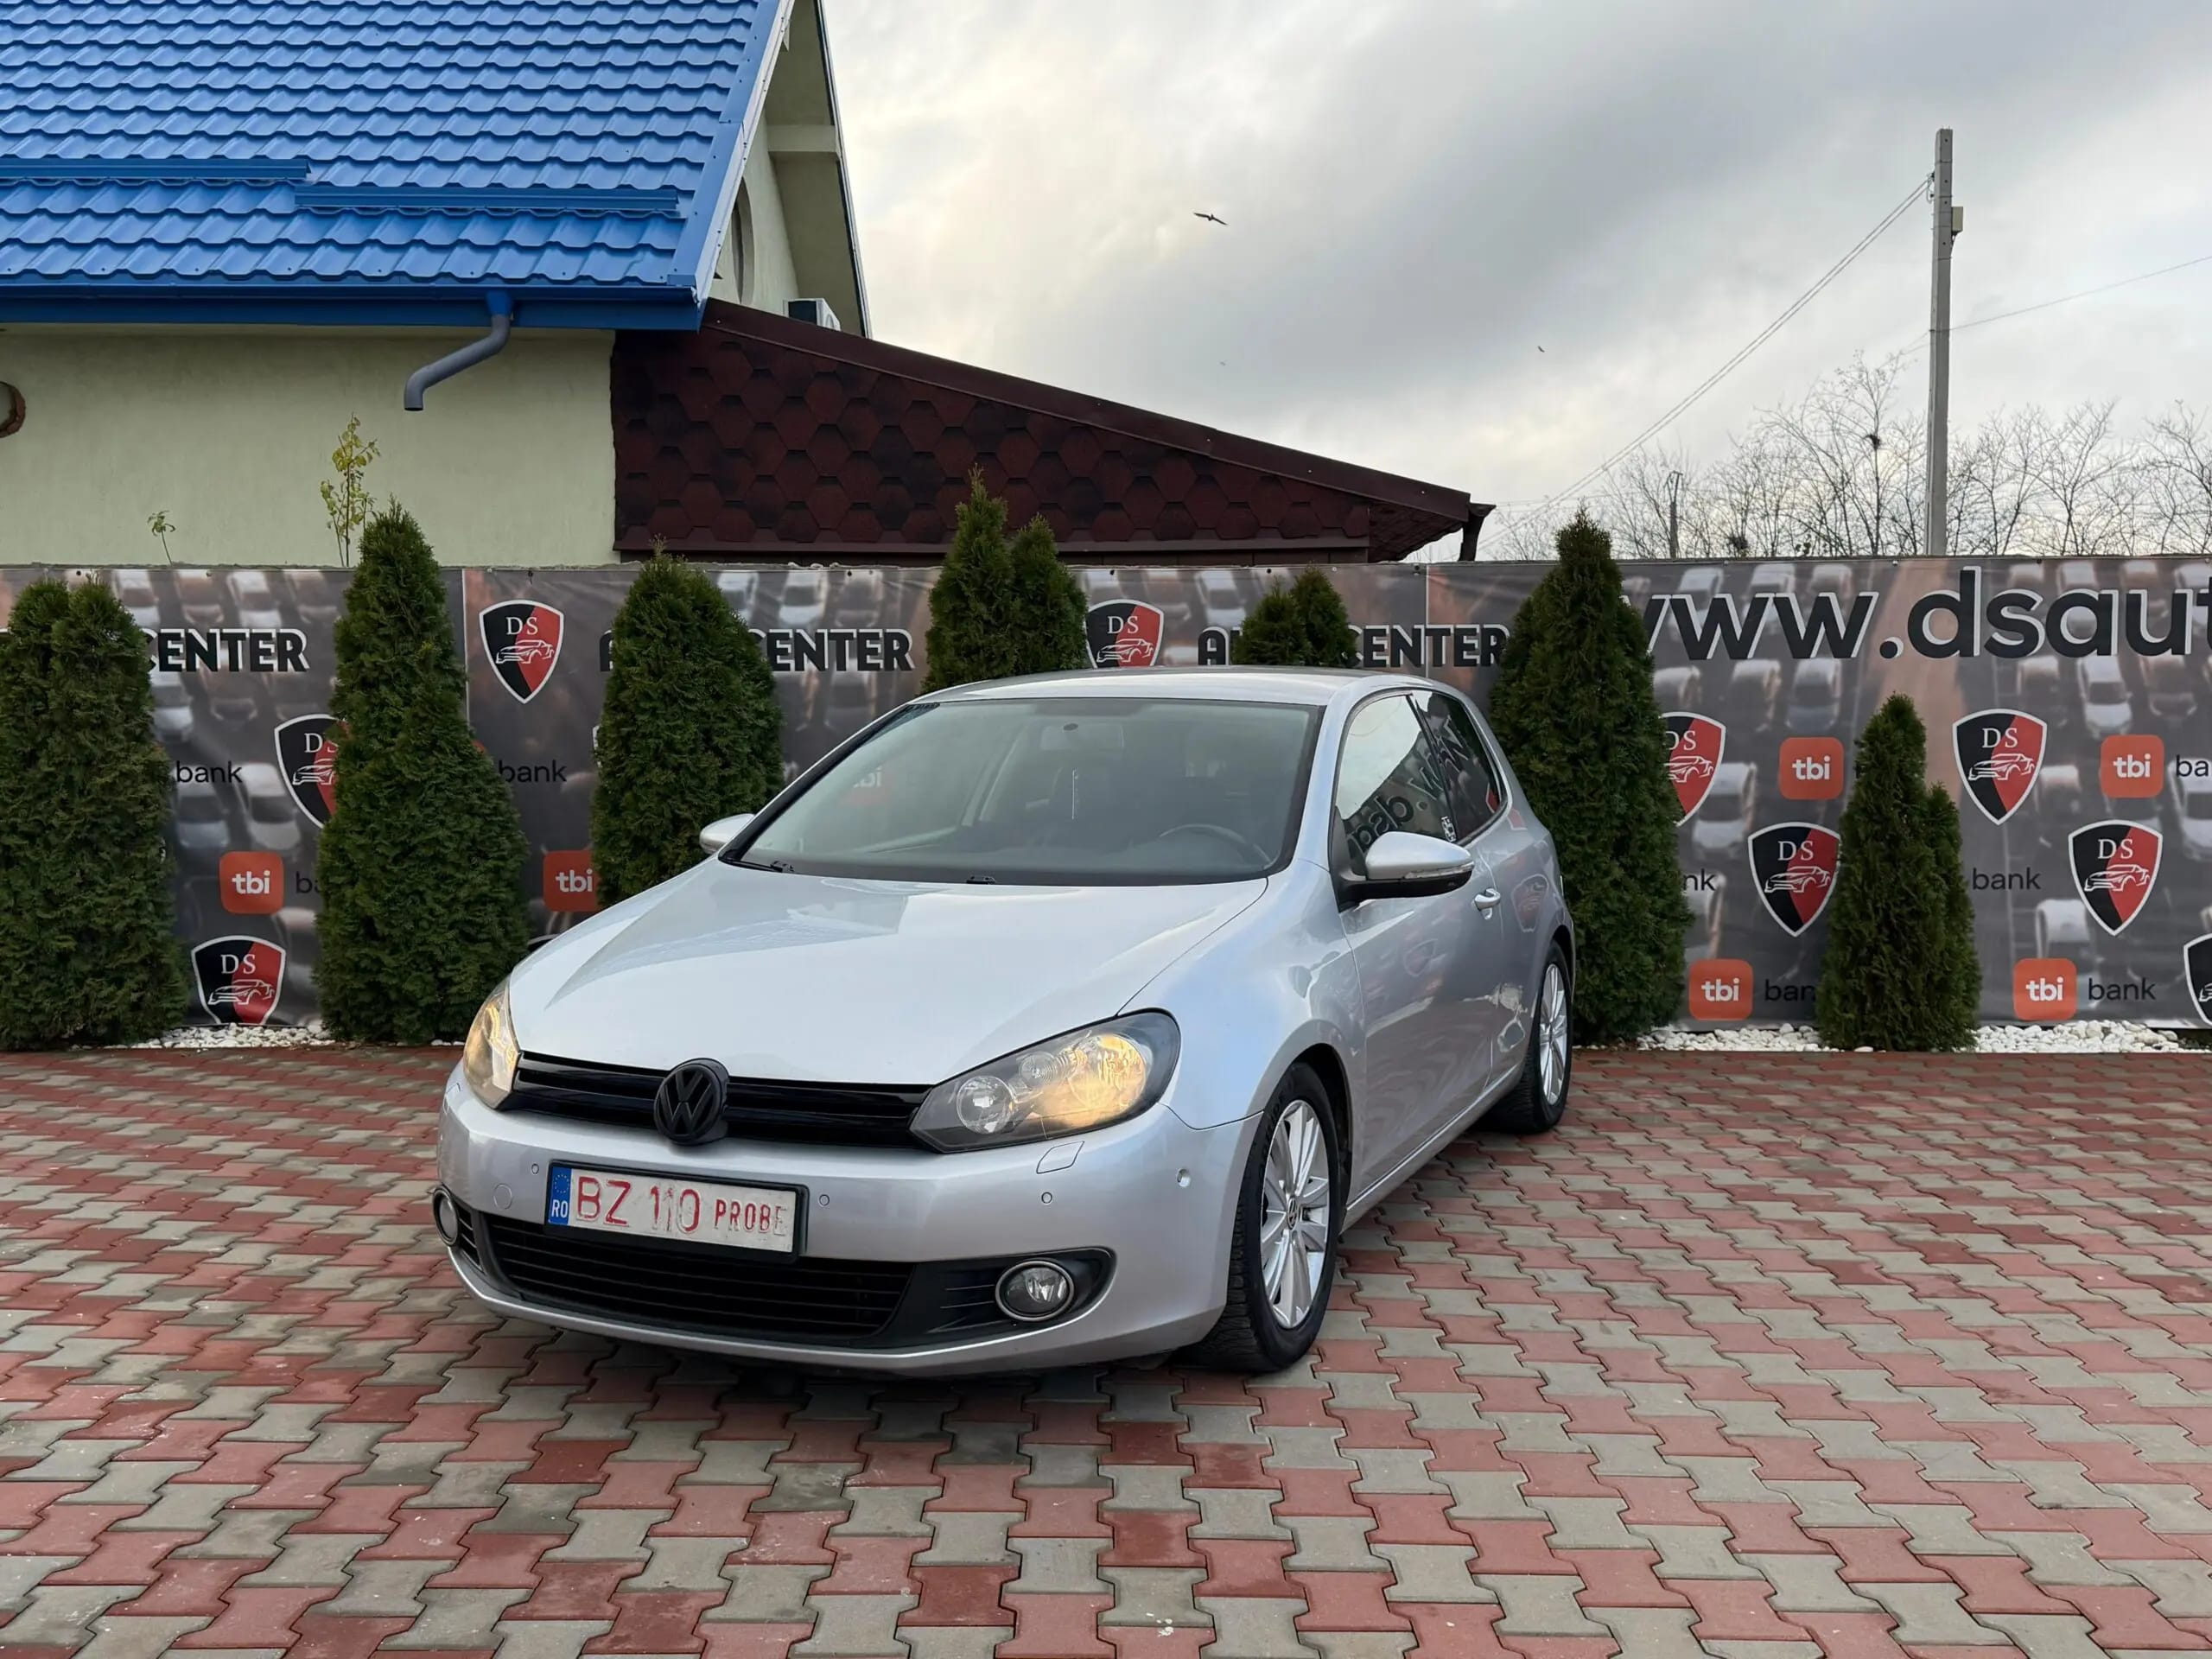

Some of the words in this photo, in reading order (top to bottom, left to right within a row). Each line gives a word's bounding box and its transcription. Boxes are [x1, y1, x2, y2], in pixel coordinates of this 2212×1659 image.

[1643, 566, 2212, 659] ww.dsau
[506, 616, 539, 635] DS
[1107, 615, 1140, 634] DS
[748, 628, 915, 671] ENTER
[1981, 727, 2019, 748] DS
[176, 760, 243, 783] bank
[498, 760, 568, 783] bank
[1791, 755, 1831, 780] tbi
[2113, 753, 2152, 778] tbi
[2176, 754, 2209, 778] ba
[1777, 840, 1815, 861] DS
[2097, 838, 2134, 859] DS
[232, 869, 271, 894] tbi
[555, 868, 594, 892] tbi
[1684, 868, 1716, 891] nk
[1972, 867, 2041, 890] bank
[220, 953, 257, 974] DS
[1700, 977, 1740, 1001] tbi
[1764, 979, 1816, 1001] ban
[2025, 976, 2064, 1001] tbi
[2088, 977, 2156, 1001] bank
[551, 1199, 569, 1219] RO
[576, 1176, 632, 1226] BZ
[650, 1185, 701, 1235] 110
[715, 1198, 787, 1236] PROBE
